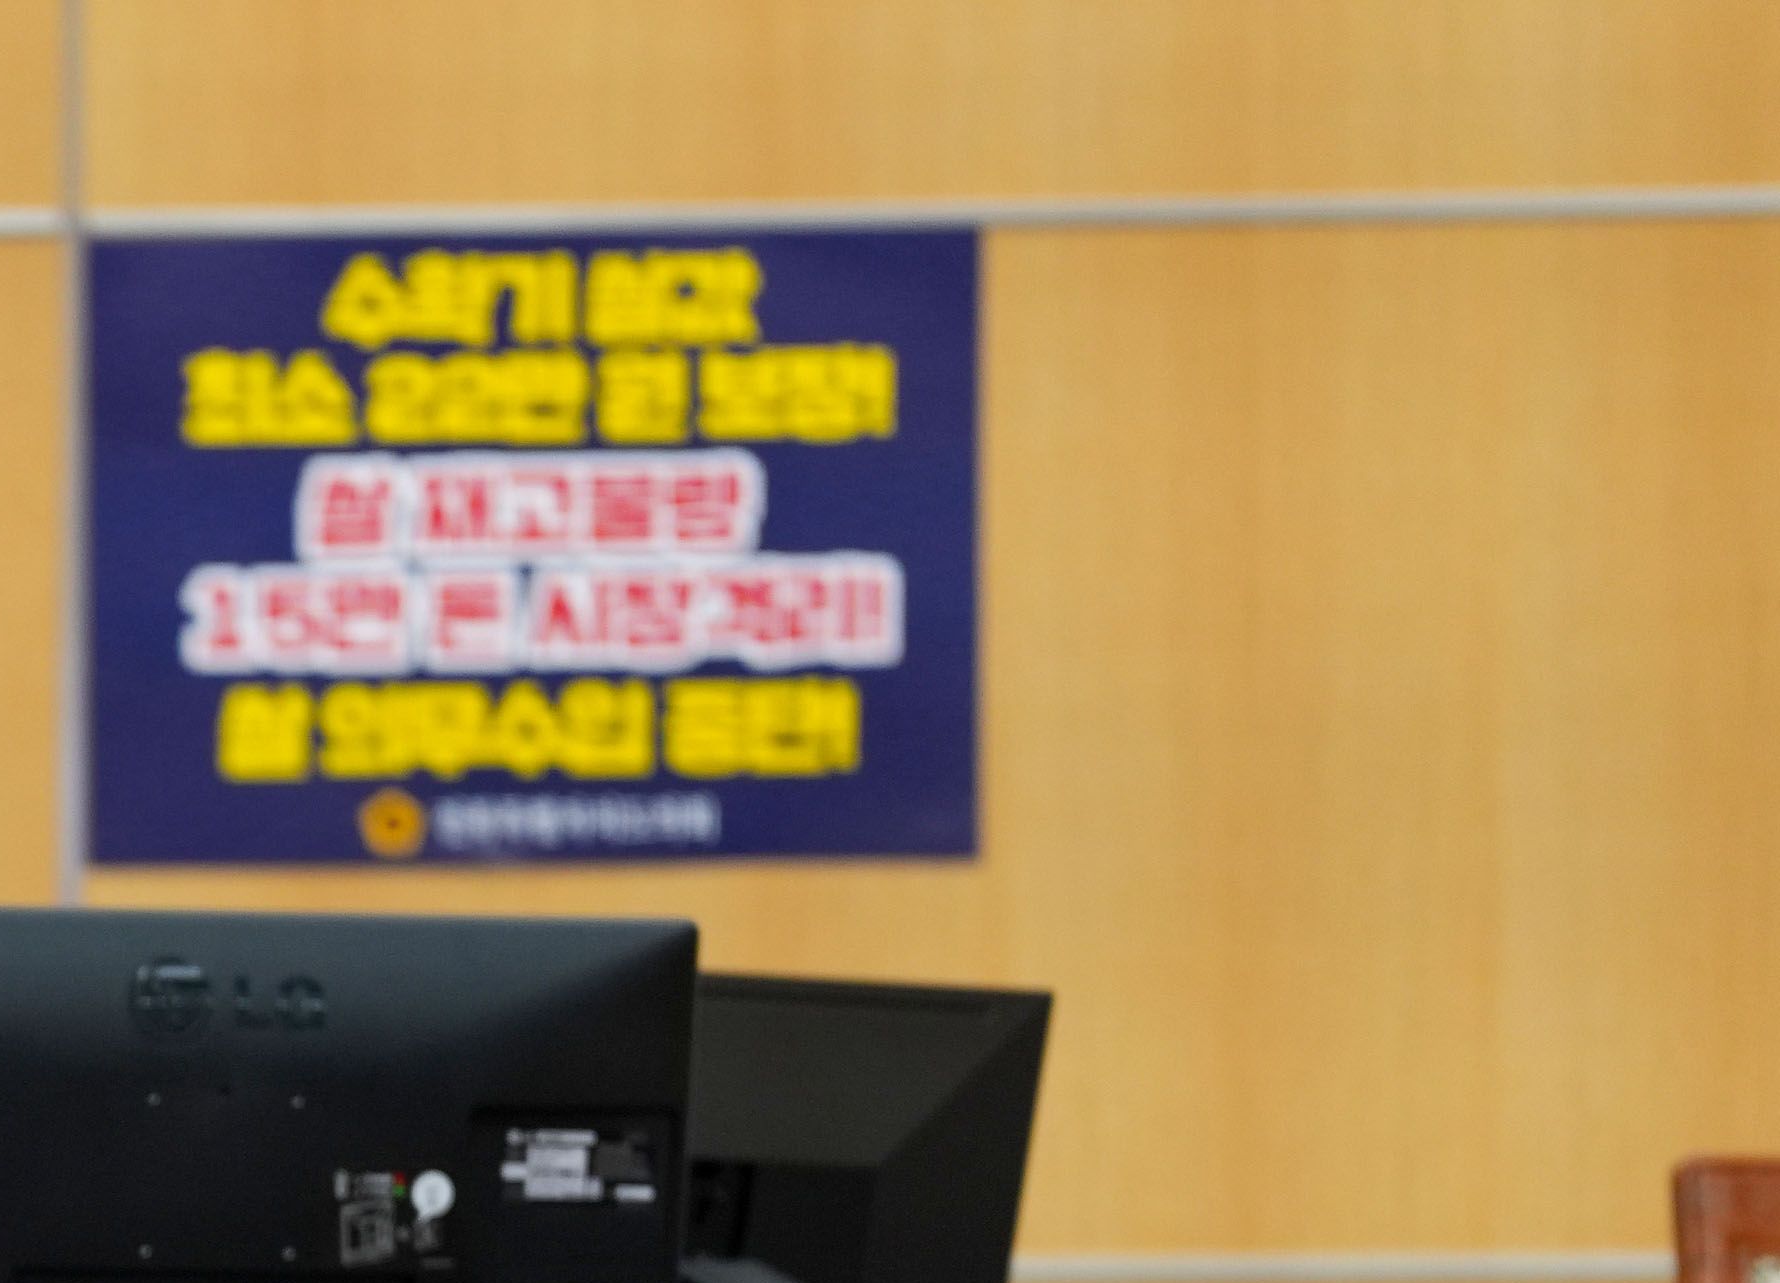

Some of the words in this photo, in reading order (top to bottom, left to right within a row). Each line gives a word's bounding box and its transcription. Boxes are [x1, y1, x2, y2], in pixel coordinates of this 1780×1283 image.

[315, 472, 393, 550] 쌀
[418, 468, 744, 549] 재고물량
[206, 578, 406, 657] 15만
